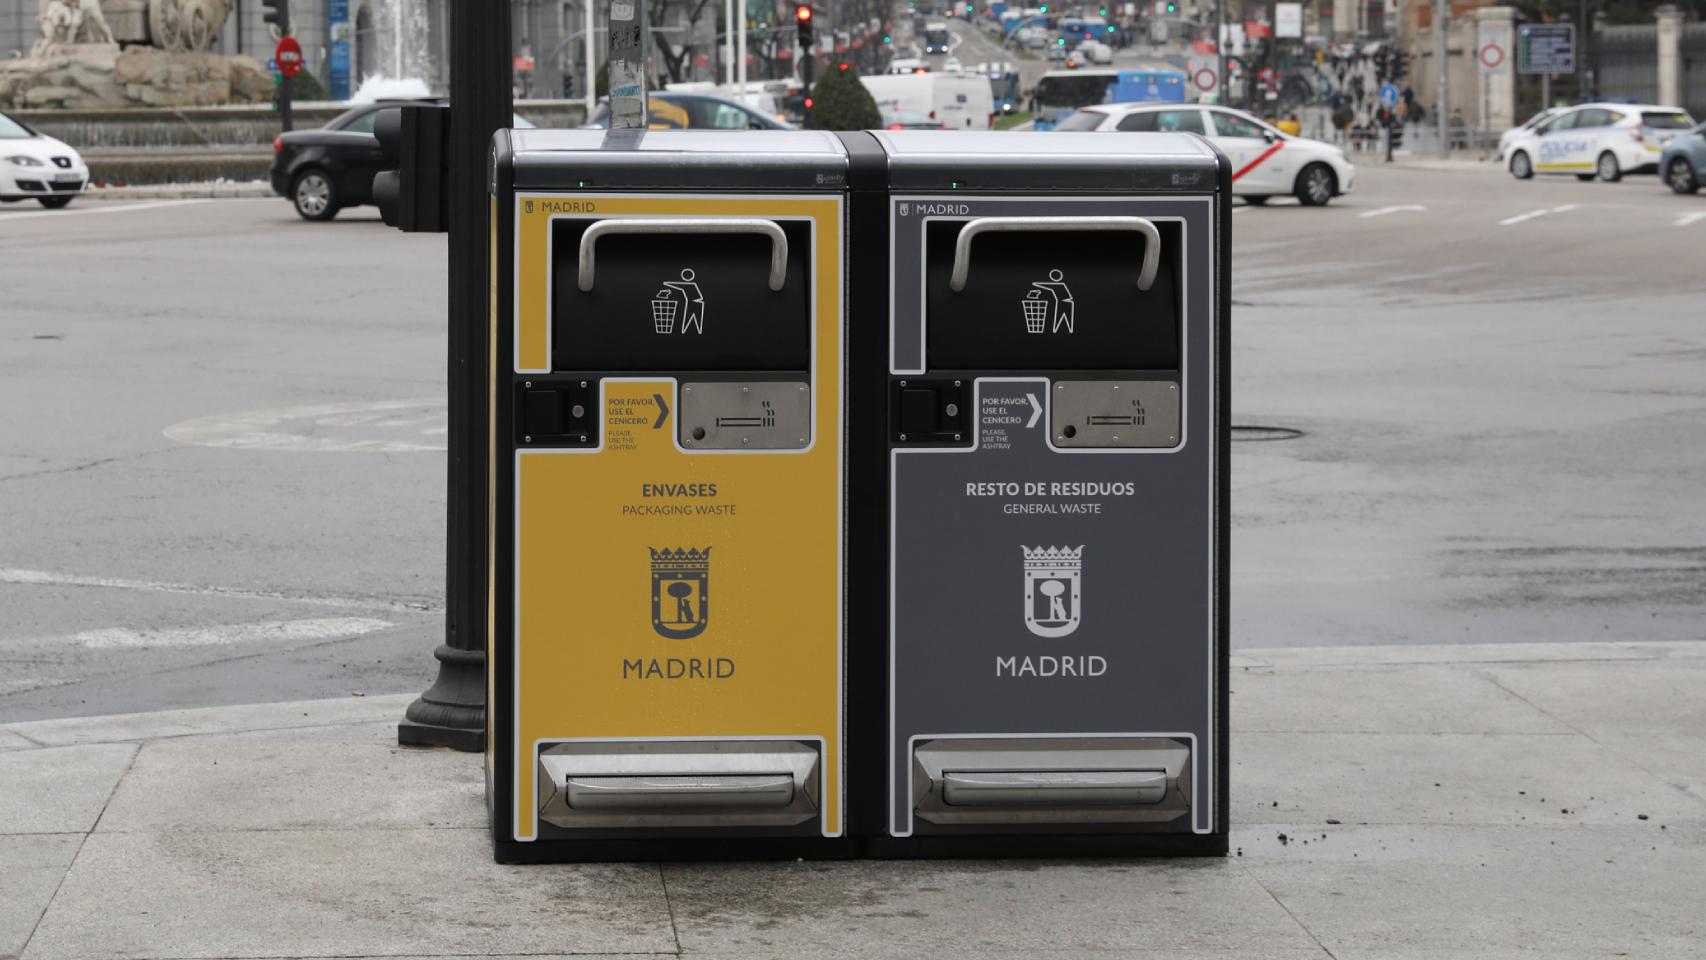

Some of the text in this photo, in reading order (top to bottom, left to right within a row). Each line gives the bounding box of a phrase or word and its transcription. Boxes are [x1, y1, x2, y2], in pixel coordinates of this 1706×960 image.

[542, 201, 596, 213] MADRID
[916, 204, 969, 215] MADRID
[608, 398, 625, 406] POR
[608, 417, 648, 425] CENICERO
[982, 416, 1022, 424] CENICERO
[642, 483, 718, 497] ENVASES
[966, 482, 1135, 497] RESTO DE RESIDUOS
[622, 504, 737, 516] PACKAGING WASTE
[1003, 503, 1102, 514] GENERAL WASTE
[623, 658, 736, 679] MADRID
[996, 655, 1108, 677] MADRID
